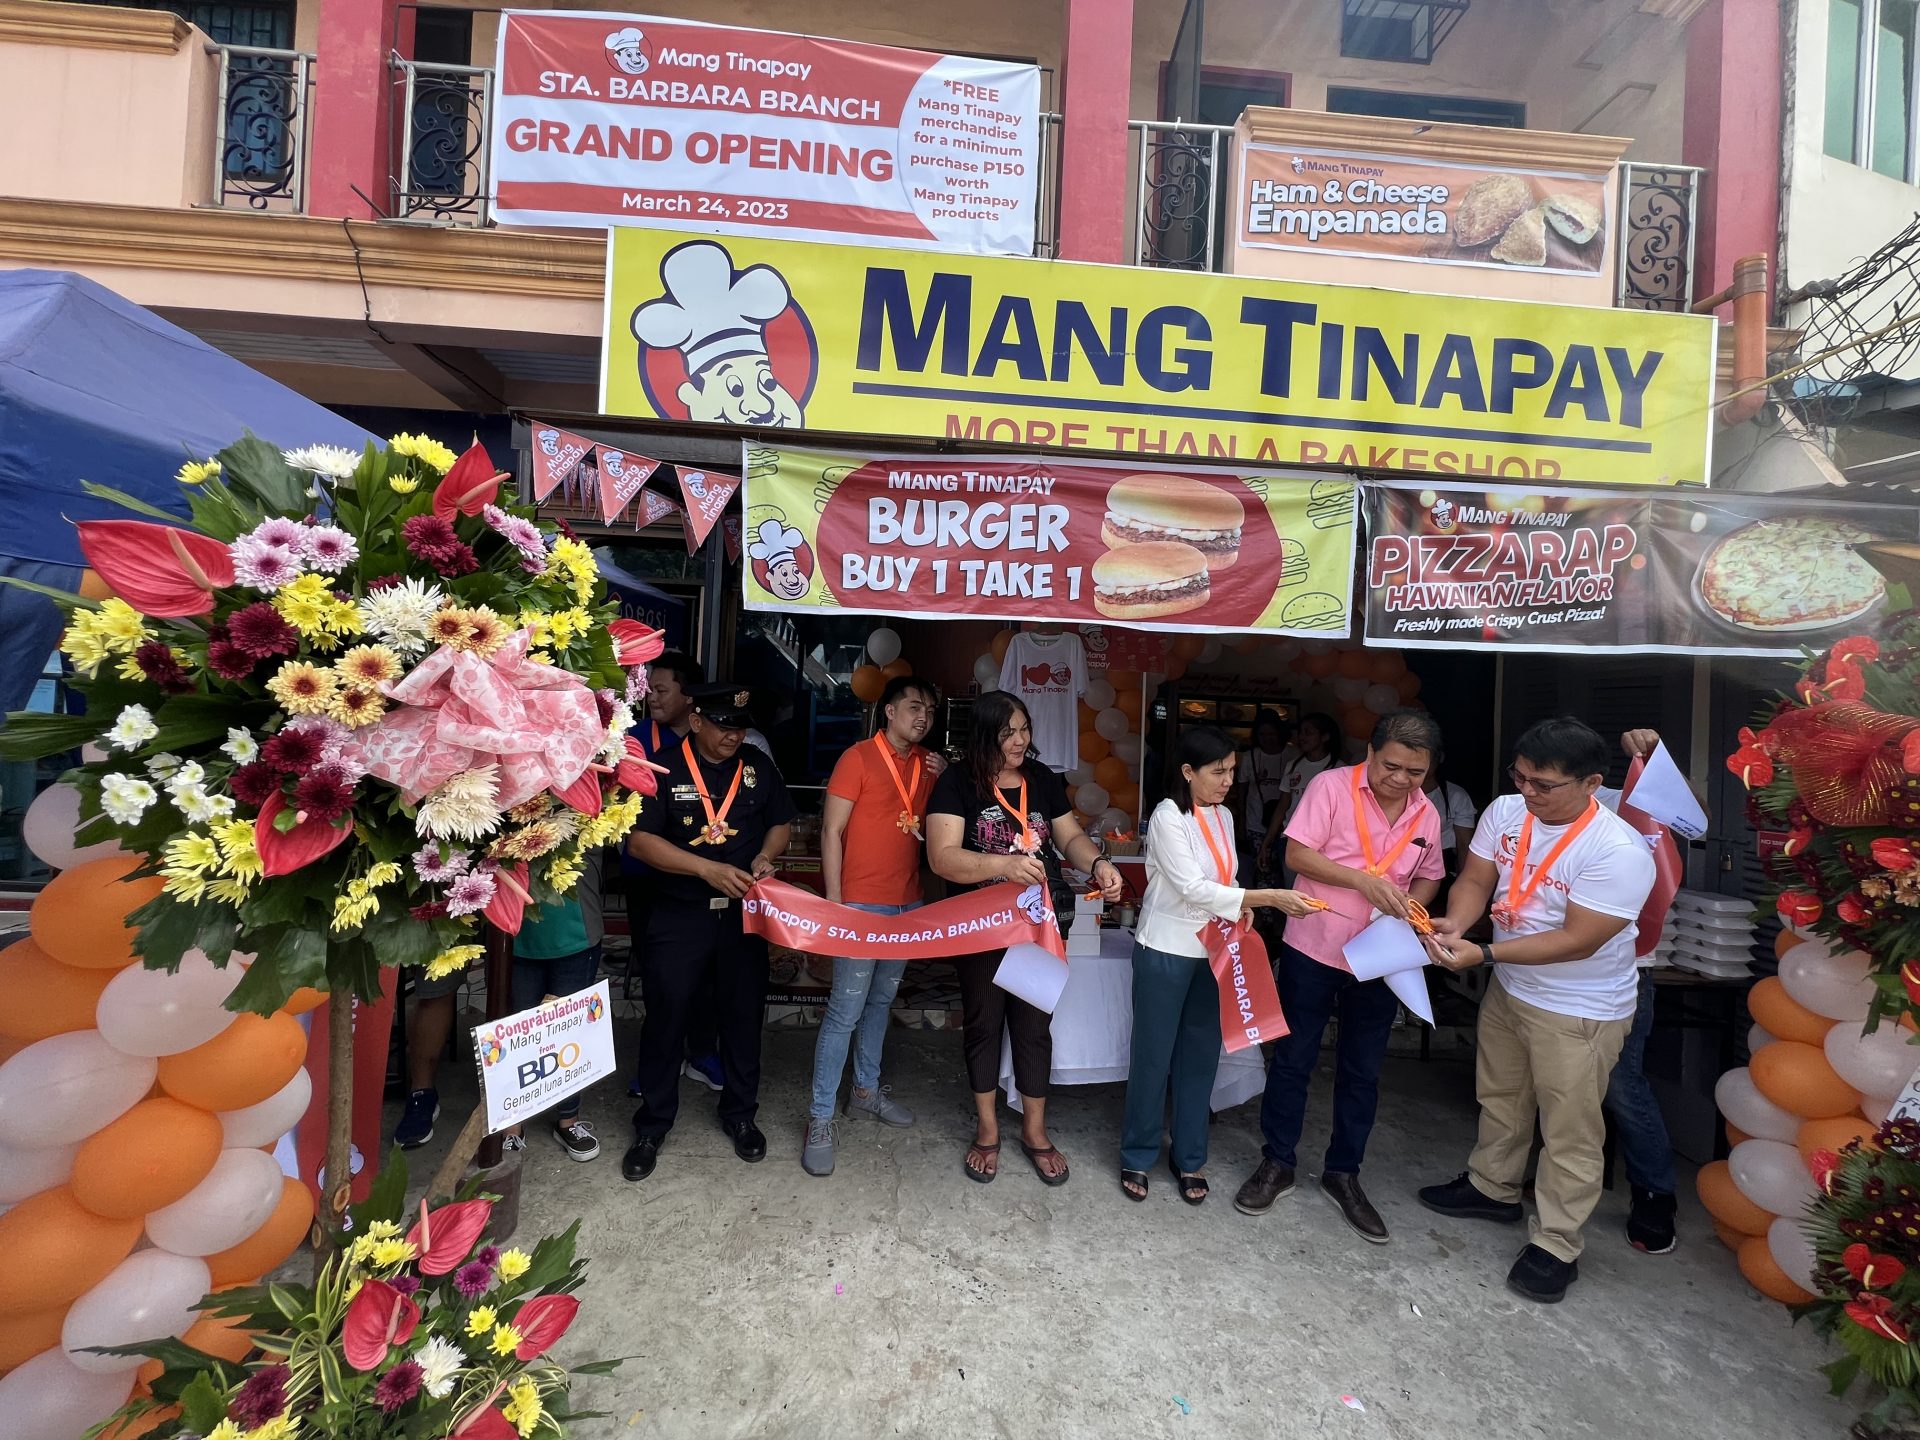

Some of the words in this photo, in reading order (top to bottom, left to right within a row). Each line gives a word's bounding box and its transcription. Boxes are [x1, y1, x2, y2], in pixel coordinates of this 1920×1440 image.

[658, 47, 720, 72] Mang
[726, 51, 812, 81] Tinapay
[538, 71, 600, 97] STA.
[609, 77, 751, 108] BARBARA
[760, 90, 881, 121] BRANCH
[918, 97, 960, 115] Mang
[964, 103, 1022, 126] Tinapay
[914, 131, 935, 144] for
[940, 136, 948, 146] a
[952, 138, 1023, 157] minimum
[921, 116, 1018, 140] merchandise
[505, 118, 673, 162] GRAND
[685, 131, 894, 182] OPENING
[910, 154, 979, 173] purchase
[983, 161, 1025, 176] P150
[945, 176, 989, 189] worth
[1307, 161, 1339, 173] MANG
[1341, 164, 1384, 177] TINAPAY
[622, 191, 692, 213] March
[697, 196, 731, 217] 24,
[737, 200, 789, 221] 2023
[914, 187, 955, 205] Mang
[960, 193, 1019, 210] Tinapay
[1251, 180, 1317, 204] Ham
[1323, 181, 1344, 203] &
[1346, 180, 1449, 204] Cheese
[932, 208, 1000, 221] products
[1248, 203, 1448, 241] Empanada
[854, 267, 1213, 393] MANG
[1239, 296, 1664, 431] TINAPAY
[945, 414, 1089, 448] MORE
[1106, 425, 1237, 459] THAN
[546, 442, 574, 470] Mang
[548, 445, 585, 481] Tinapay
[613, 464, 640, 492] Mang
[616, 465, 651, 502] Tinapay
[888, 471, 959, 492] MANG
[961, 471, 1056, 496] TINAPAY
[698, 483, 723, 513] Mang
[703, 483, 734, 522] Tinapay
[868, 496, 1070, 553] BURGER
[1457, 505, 1508, 526] MANG
[1509, 507, 1572, 527] TINAPAY
[1369, 522, 1637, 590] PIZZARAP
[841, 552, 921, 594] BUY
[932, 559, 948, 595] 1
[959, 560, 1054, 600] TAKE
[1066, 566, 1082, 601] 1
[1385, 582, 1518, 612] HAWAIIAN
[1511, 576, 1613, 607] FLAVOR
[1394, 617, 1445, 634] Freshly
[1446, 616, 1484, 630] made
[1485, 613, 1525, 630] Crispy
[1527, 610, 1563, 625] Crust
[1565, 606, 1606, 622] Pizza!
[1022, 687, 1042, 695] Mang
[758, 898, 822, 935] Tinapay
[827, 926, 861, 942] STA.
[866, 928, 944, 944] BARBARA
[947, 909, 1014, 938] BRANCH
[1227, 941, 1255, 1025] BARBARA
[510, 1030, 542, 1052] Mang
[545, 1013, 584, 1037] Tinapay
[539, 1042, 556, 1055] from
[517, 1041, 580, 1089] BDO
[503, 1085, 543, 1111] General
[564, 1059, 593, 1083] Branch
